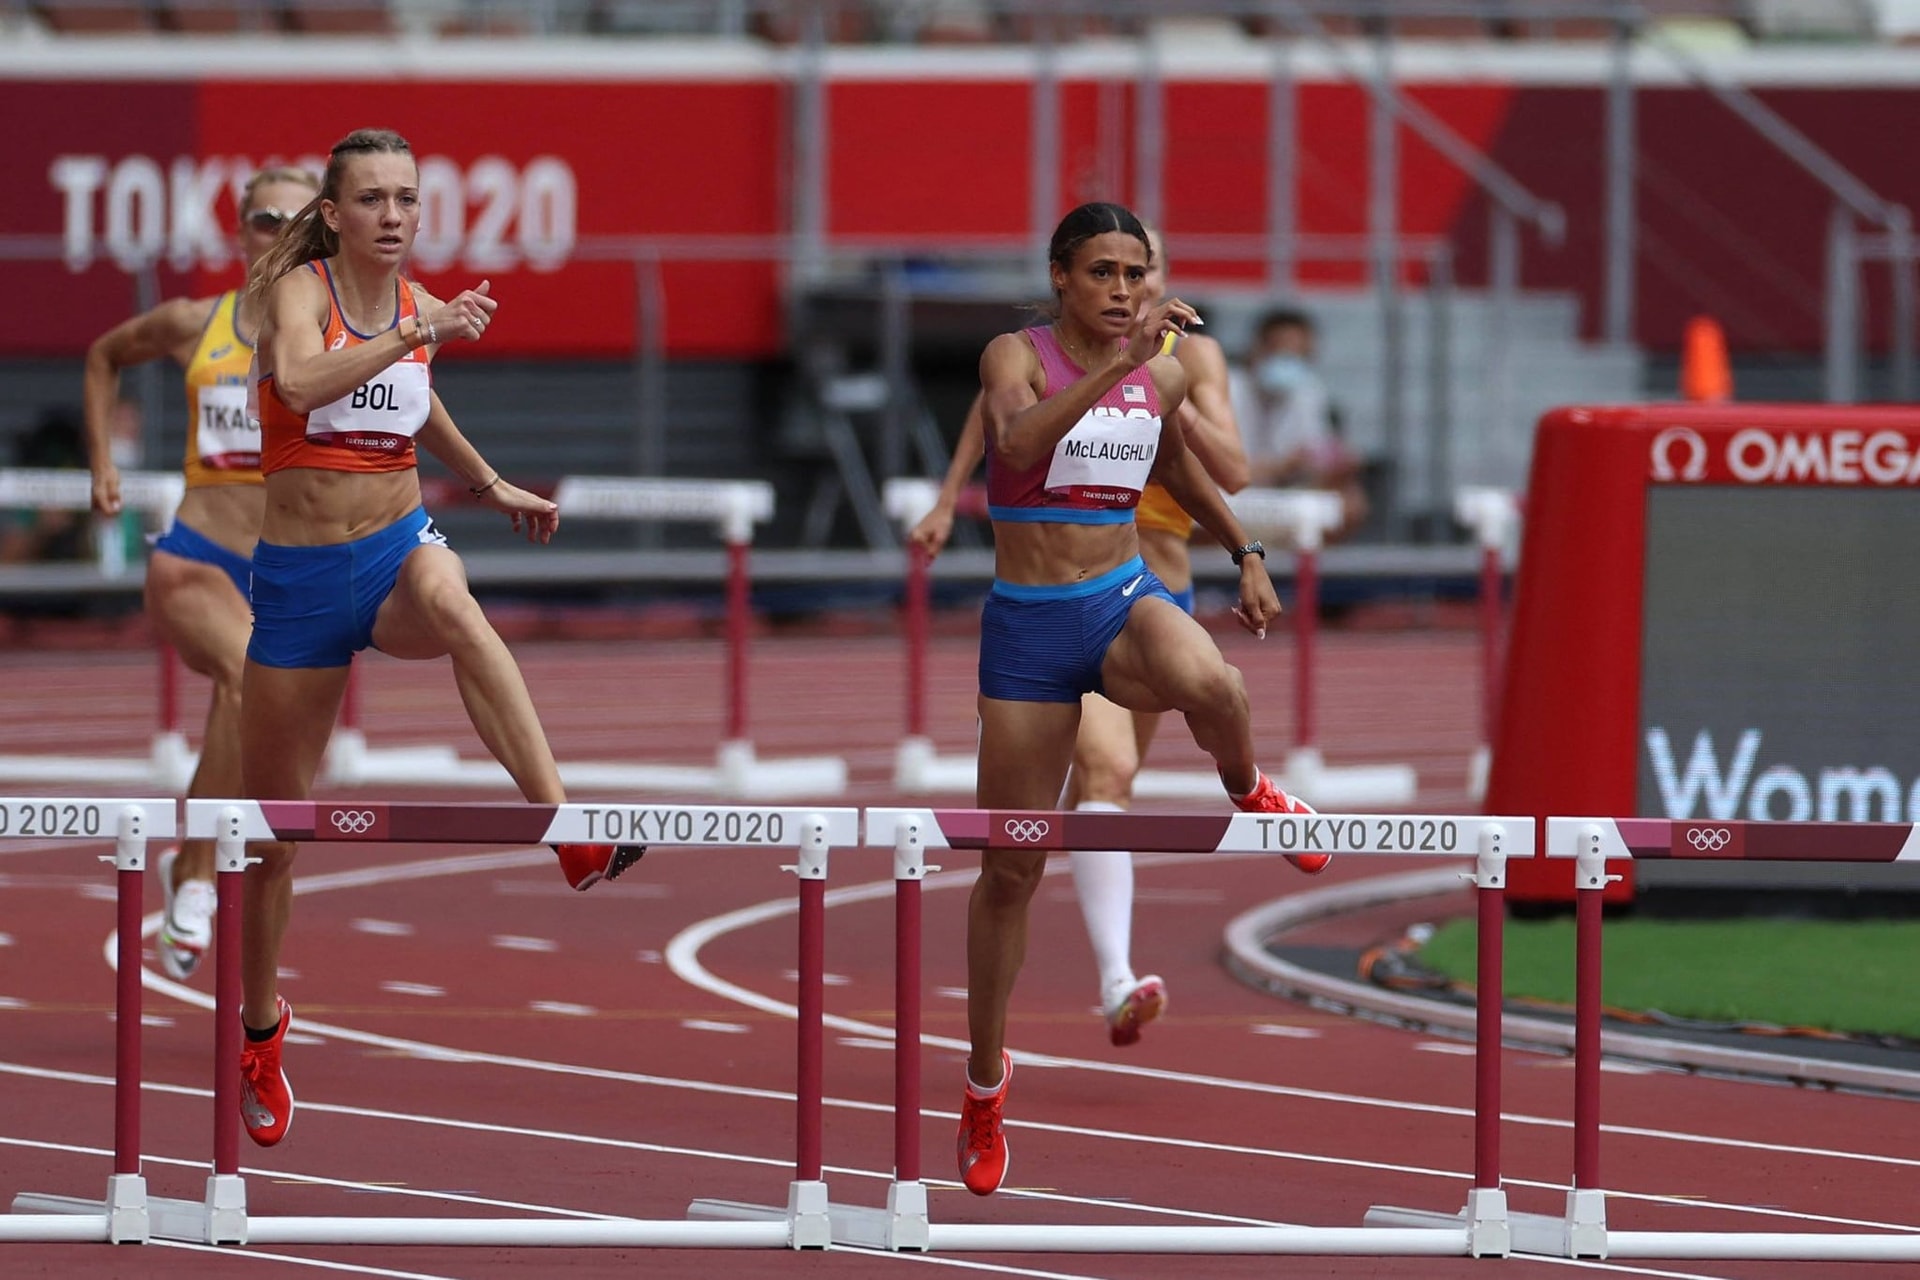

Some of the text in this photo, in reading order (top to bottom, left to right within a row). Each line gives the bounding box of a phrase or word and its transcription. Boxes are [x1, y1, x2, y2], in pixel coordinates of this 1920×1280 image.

[51, 154, 578, 274] TOK 020
[351, 383, 399, 410] BOL
[1082, 490, 1116, 501] TOKYO 2020
[1646, 726, 1920, 822] Wom
[19, 804, 100, 834] 2020
[582, 810, 784, 843] TOKYO 2020
[1256, 818, 1457, 851] TOKYO 2020
